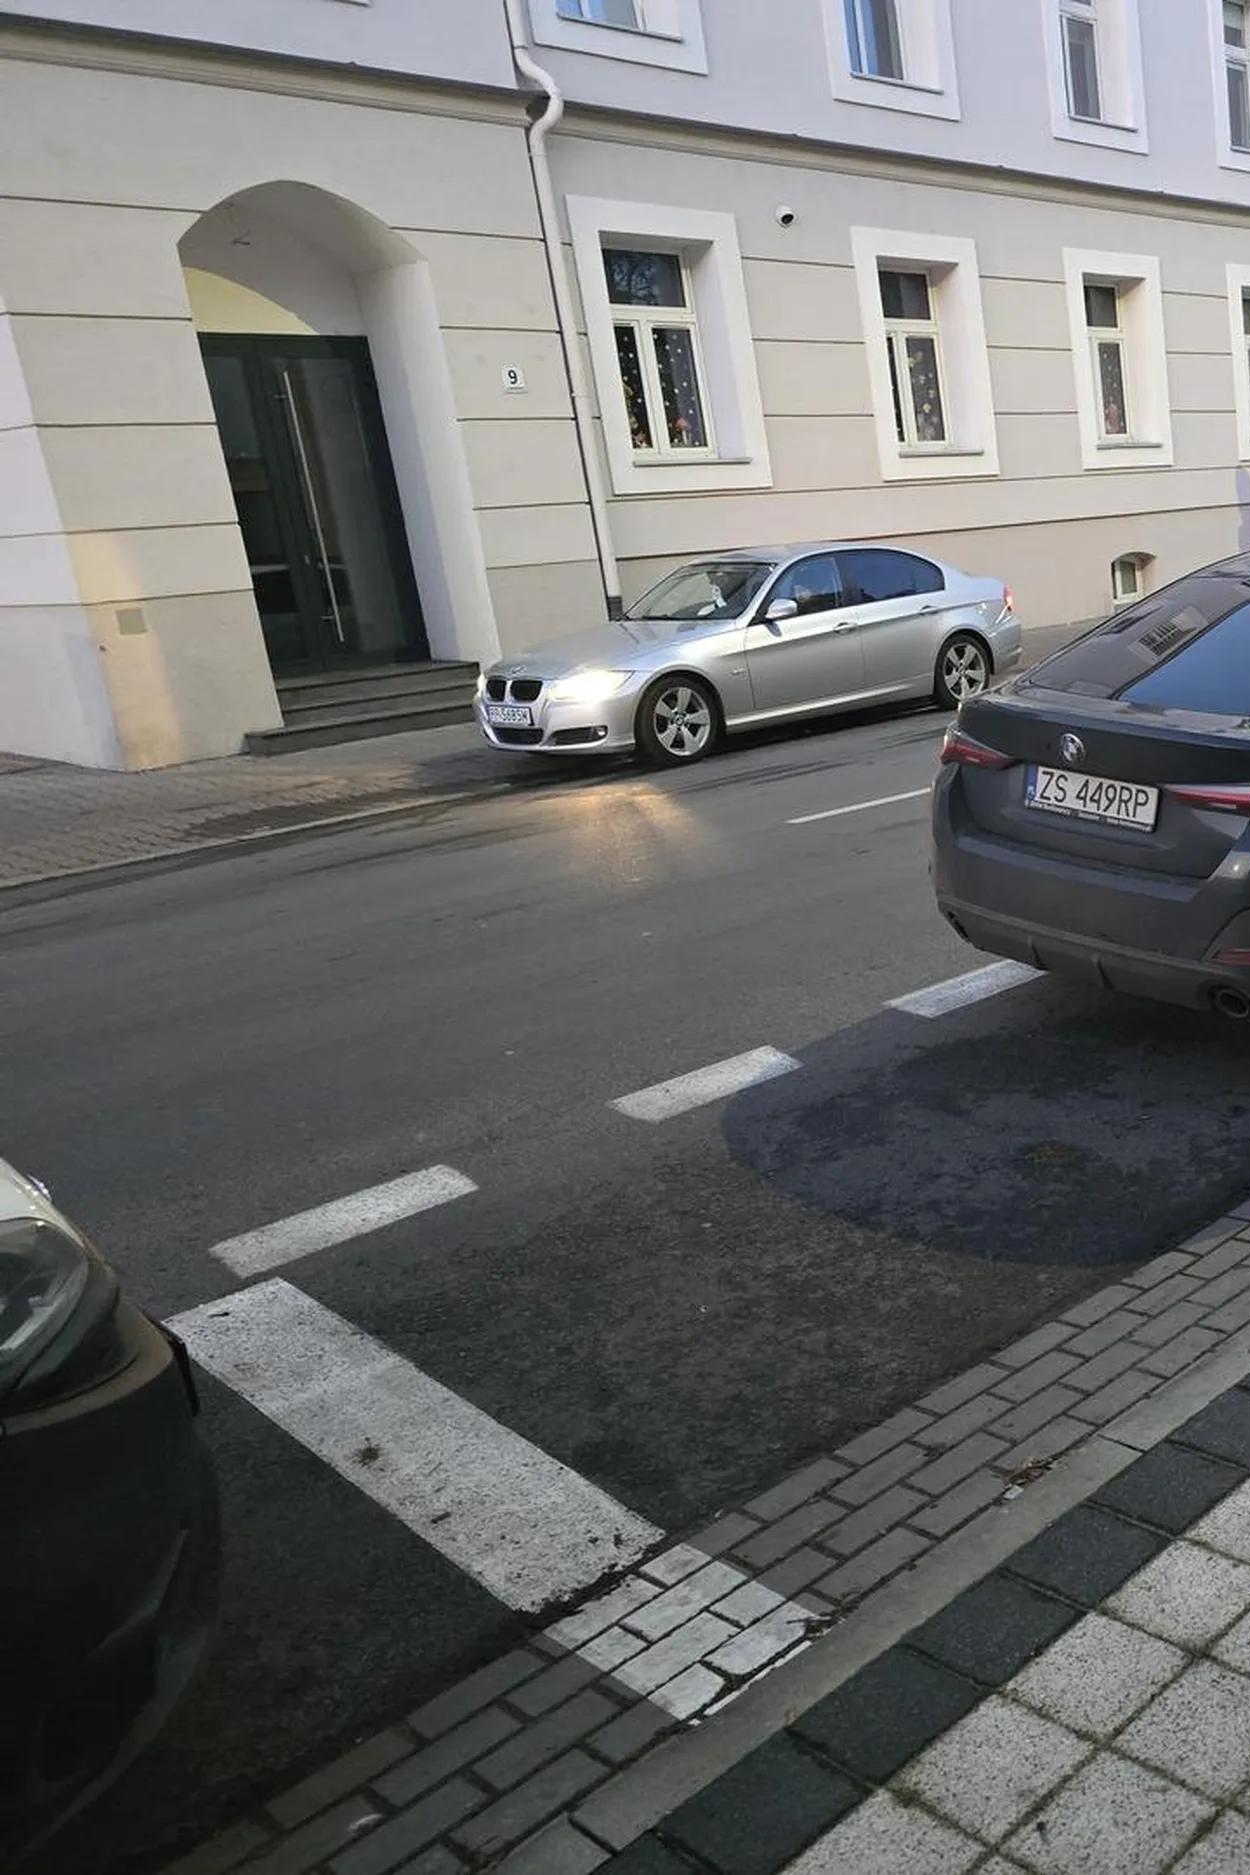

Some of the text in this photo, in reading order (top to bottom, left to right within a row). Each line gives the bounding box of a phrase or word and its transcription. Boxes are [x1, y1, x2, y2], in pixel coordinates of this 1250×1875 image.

[508, 369, 518, 385] 9
[1040, 772, 1068, 803] ZS
[1076, 779, 1149, 818] 449RP
